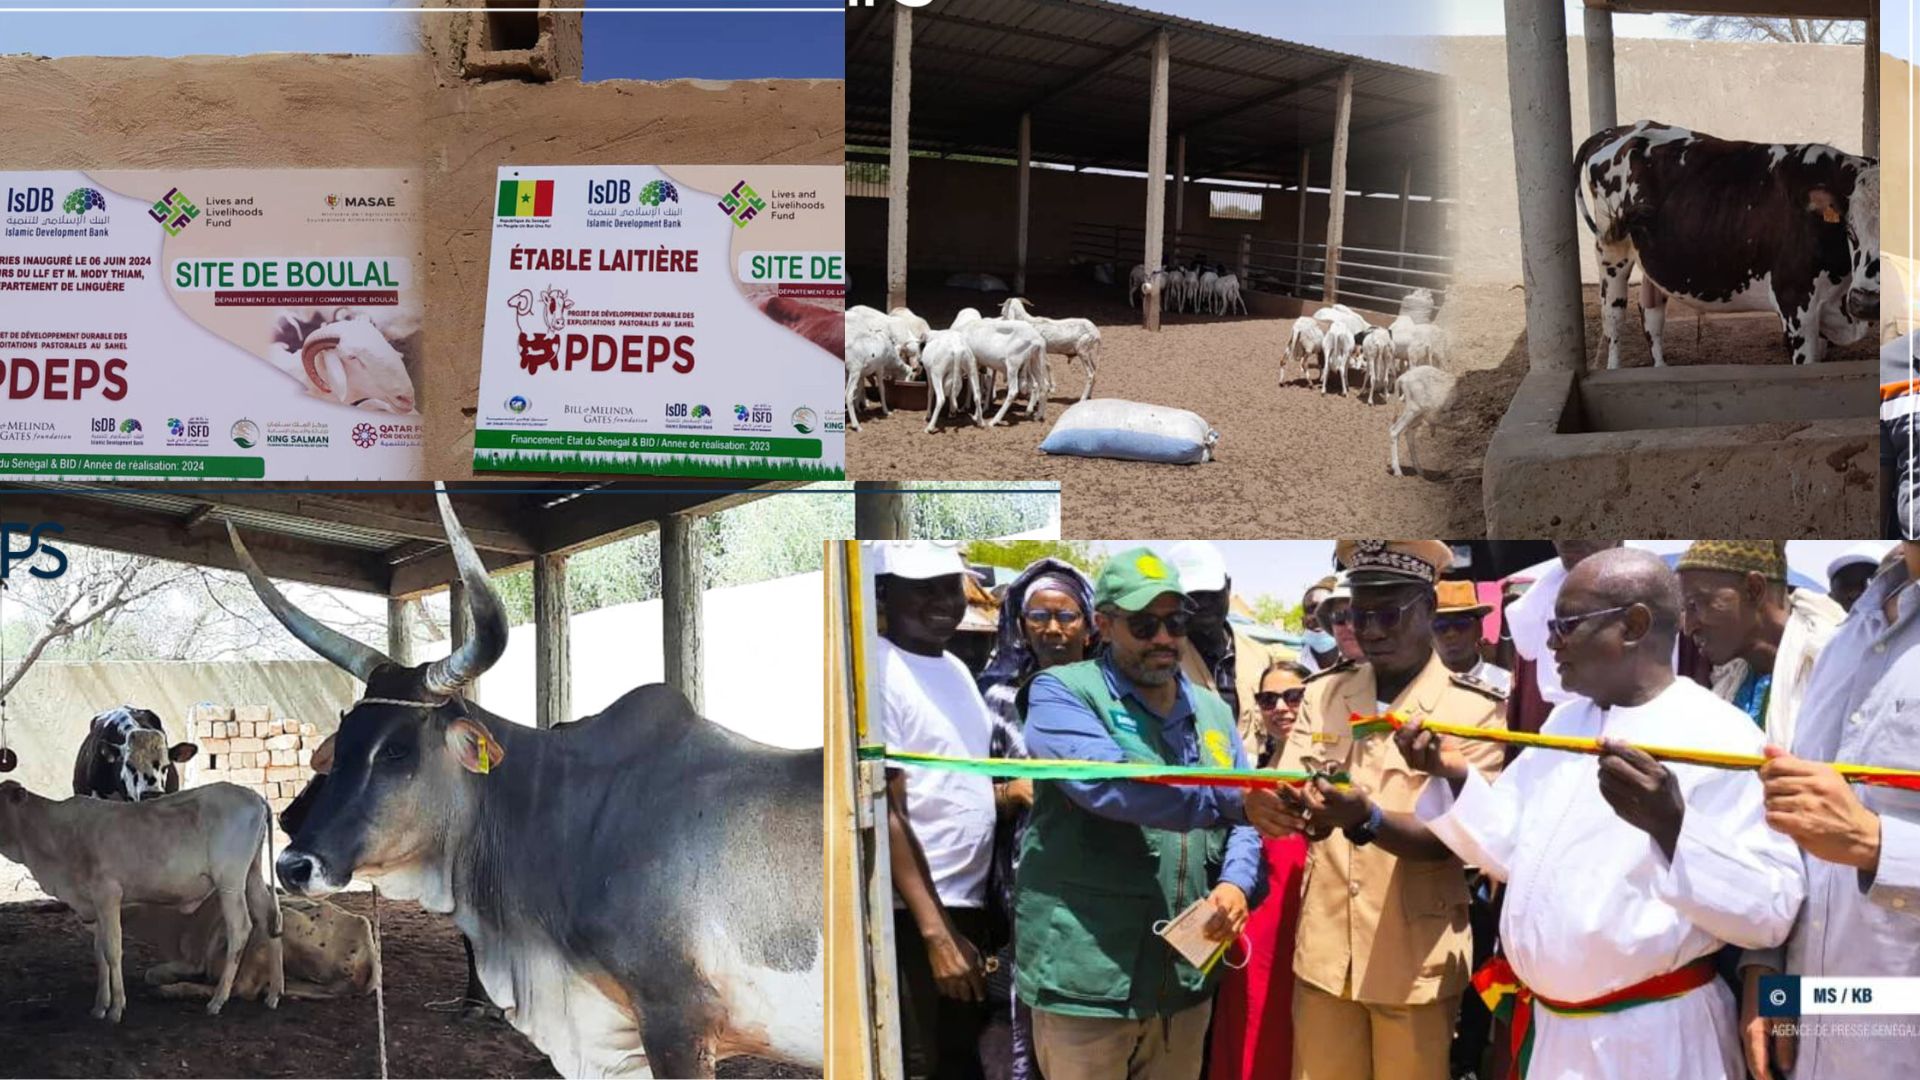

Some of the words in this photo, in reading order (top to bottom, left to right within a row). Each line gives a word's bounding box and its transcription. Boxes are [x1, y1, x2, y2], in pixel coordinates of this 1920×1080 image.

[588, 180, 631, 204] IsDB
[771, 190, 796, 198] Lives
[798, 190, 816, 198] and
[7, 188, 54, 212] IsDB
[206, 197, 232, 205] Lives
[234, 197, 254, 205] and
[344, 197, 396, 207] MASAE
[771, 201, 825, 209] Livelihoods
[206, 208, 264, 216] Livelihoods
[771, 212, 796, 220] Fund
[206, 219, 232, 227] Fund
[586, 219, 613, 228] Islamic
[614, 219, 662, 229] Development
[663, 219, 682, 228] Bank
[5, 228, 34, 237] Islamic
[35, 228, 87, 238] Development
[89, 228, 109, 237] Bank
[23, 254, 73, 265] INAUGURÉ
[75, 257, 87, 265] LE
[89, 257, 101, 265] 06
[103, 257, 126, 265] JUIN
[128, 257, 152, 265] 2024
[510, 243, 592, 271] ÉTABLE
[599, 244, 699, 272] LAITIÈRE
[752, 255, 803, 279] SITE
[811, 256, 842, 279] DE
[17, 269, 30, 278] DU
[33, 269, 49, 278] LLF
[52, 269, 65, 278] ET
[67, 269, 78, 278] M.
[80, 269, 108, 278] MODY
[110, 269, 145, 280] THIAM,
[176, 262, 235, 287] SITE
[242, 262, 279, 287] DE
[287, 261, 399, 287] BOULAL
[0, 282, 58, 291] PARTEMENT
[61, 282, 73, 291] DE
[76, 280, 125, 291] LINGUÈRE
[601, 310, 652, 318] DÉVELOPPEMENT
[21, 331, 79, 339] DÉVELOPPEMENT
[81, 332, 112, 340] DURABLE
[565, 334, 695, 374] PDEPS
[564, 405, 583, 414] BILL
[590, 406, 634, 415] MELINDA
[665, 403, 688, 417] IsDB
[584, 415, 612, 424] GATES
[752, 411, 773, 423] ISFD
[7, 422, 55, 431] MELINDA
[91, 418, 116, 432] IsDB
[379, 424, 412, 433] QATAR
[823, 422, 844, 430] KING
[187, 425, 209, 437] ISFD
[0, 432, 31, 441] GATES
[267, 435, 289, 443] KING
[290, 435, 329, 444] SALMAN
[585, 436, 596, 446] du
[631, 437, 638, 447] &
[640, 437, 656, 448] BID
[661, 438, 688, 449] Année
[689, 439, 700, 449] de
[750, 441, 771, 451] 2023
[50, 460, 58, 469] &
[60, 459, 77, 469] BID
[83, 459, 113, 470] Année
[115, 460, 126, 470] de
[181, 461, 205, 471] 2024
